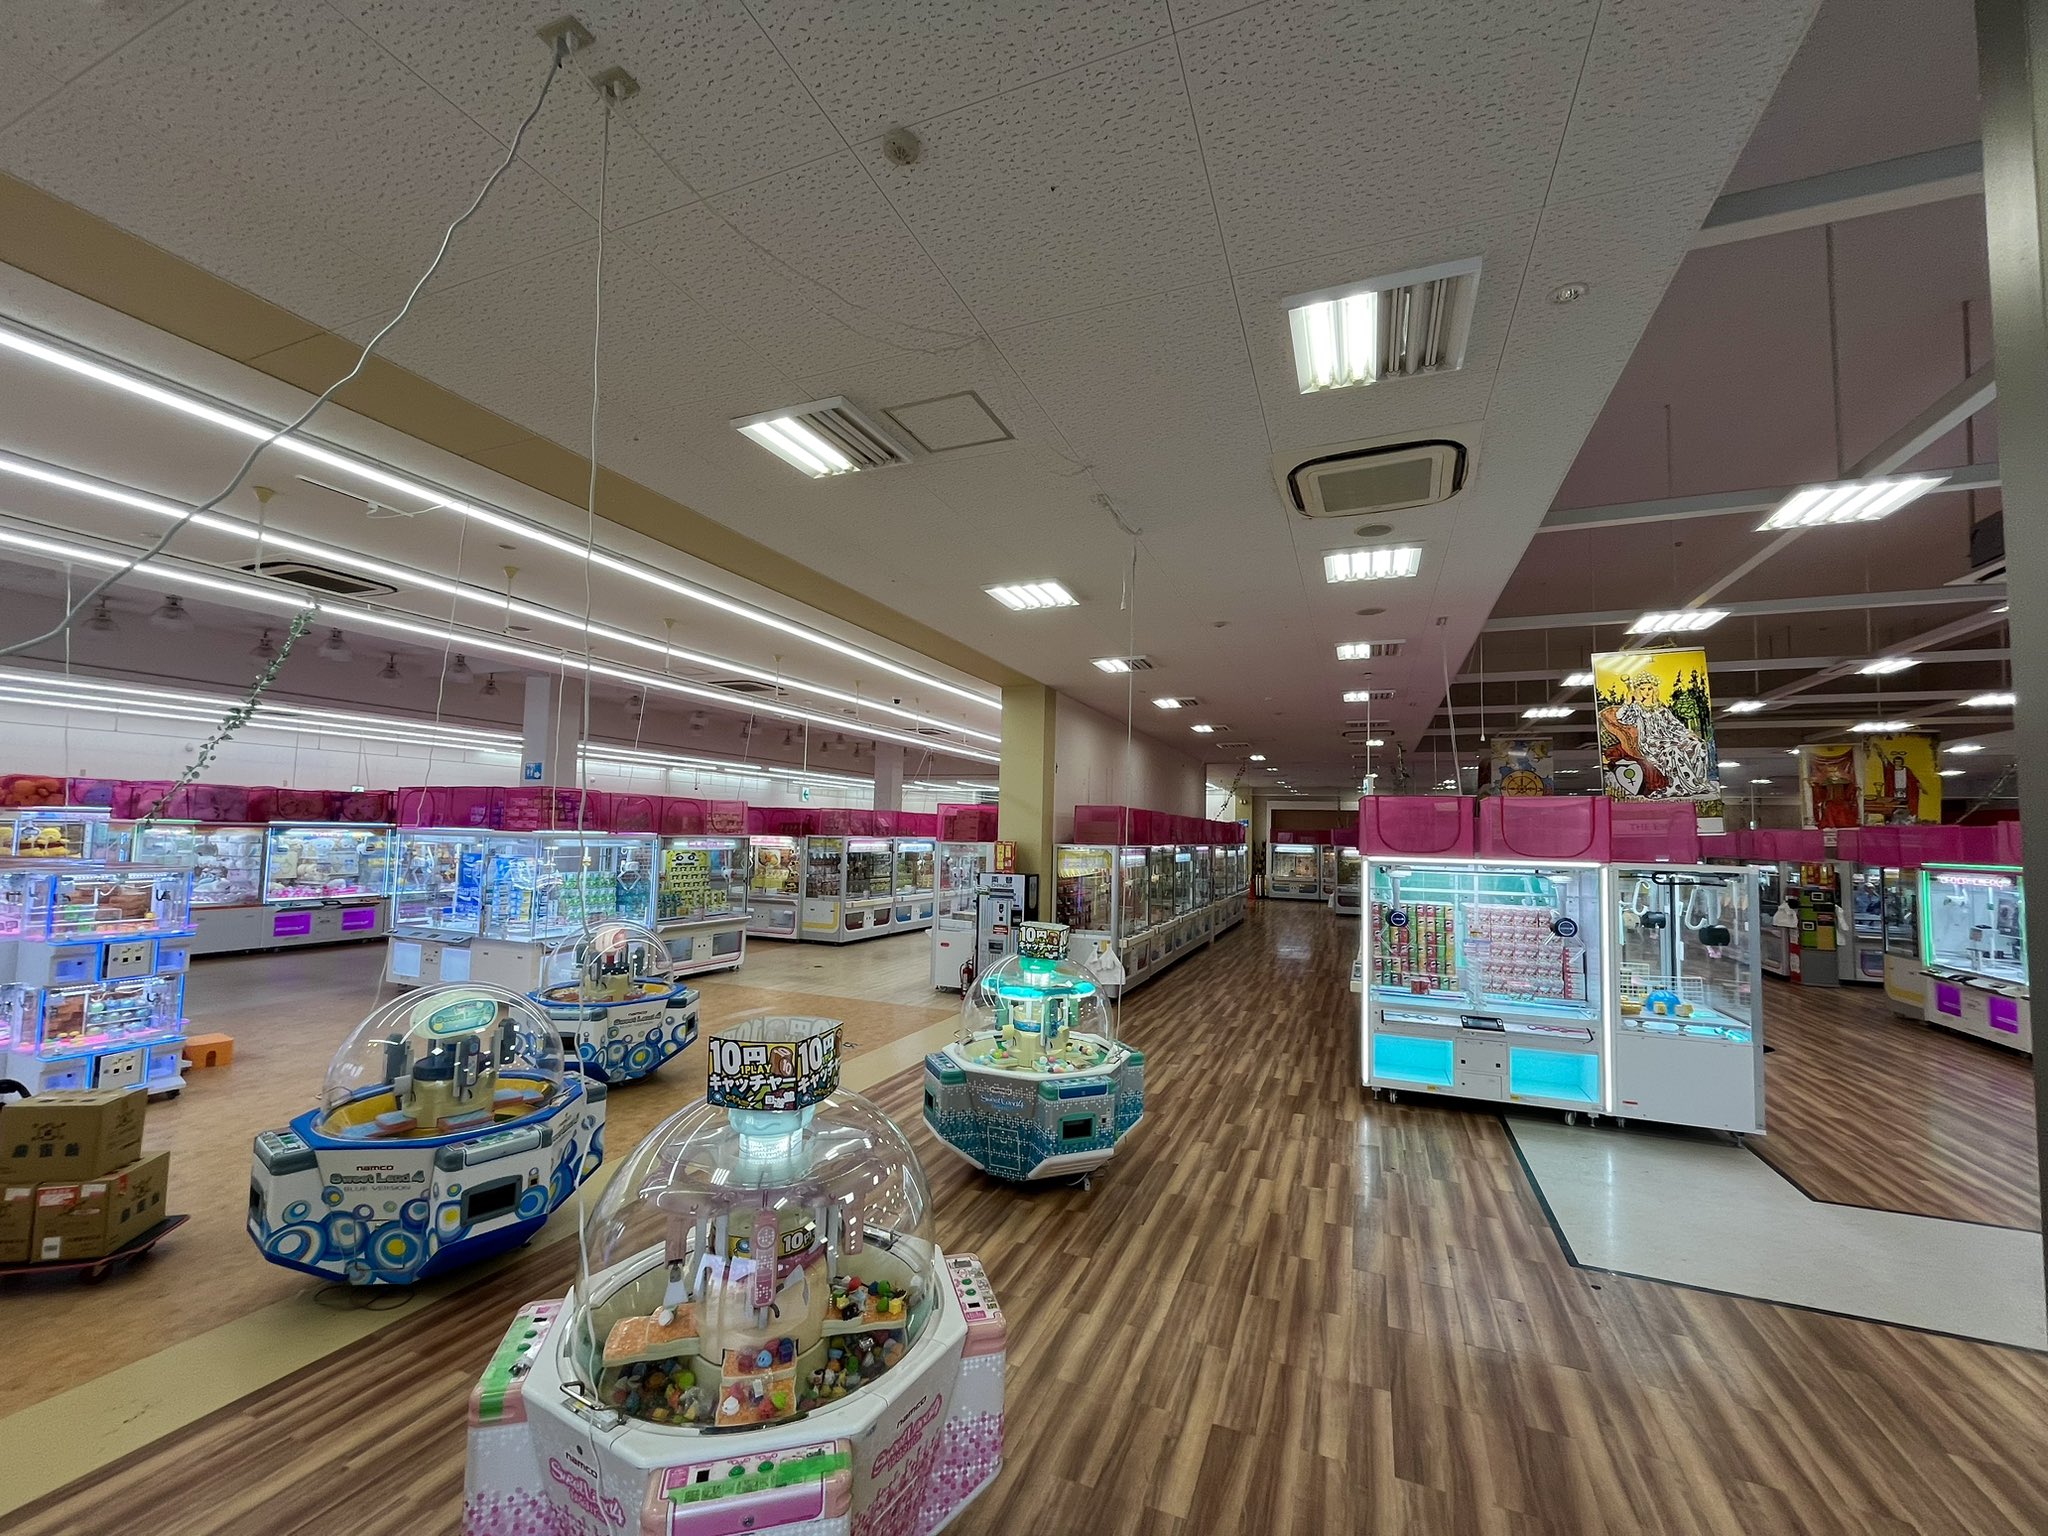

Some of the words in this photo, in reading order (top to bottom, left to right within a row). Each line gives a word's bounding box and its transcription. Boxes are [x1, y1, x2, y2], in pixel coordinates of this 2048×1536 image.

[1020, 926, 1047, 942] 10円
[709, 1040, 768, 1076] 10円
[798, 1033, 835, 1076] 10円
[739, 1064, 772, 1075] 1PLAY
[709, 1073, 797, 1093] キャッチャー
[330, 1173, 374, 1184] Sweet
[376, 1172, 410, 1184] Land
[411, 1170, 426, 1184] 4
[896, 1395, 927, 1429] namco
[565, 1451, 598, 1479] namco
